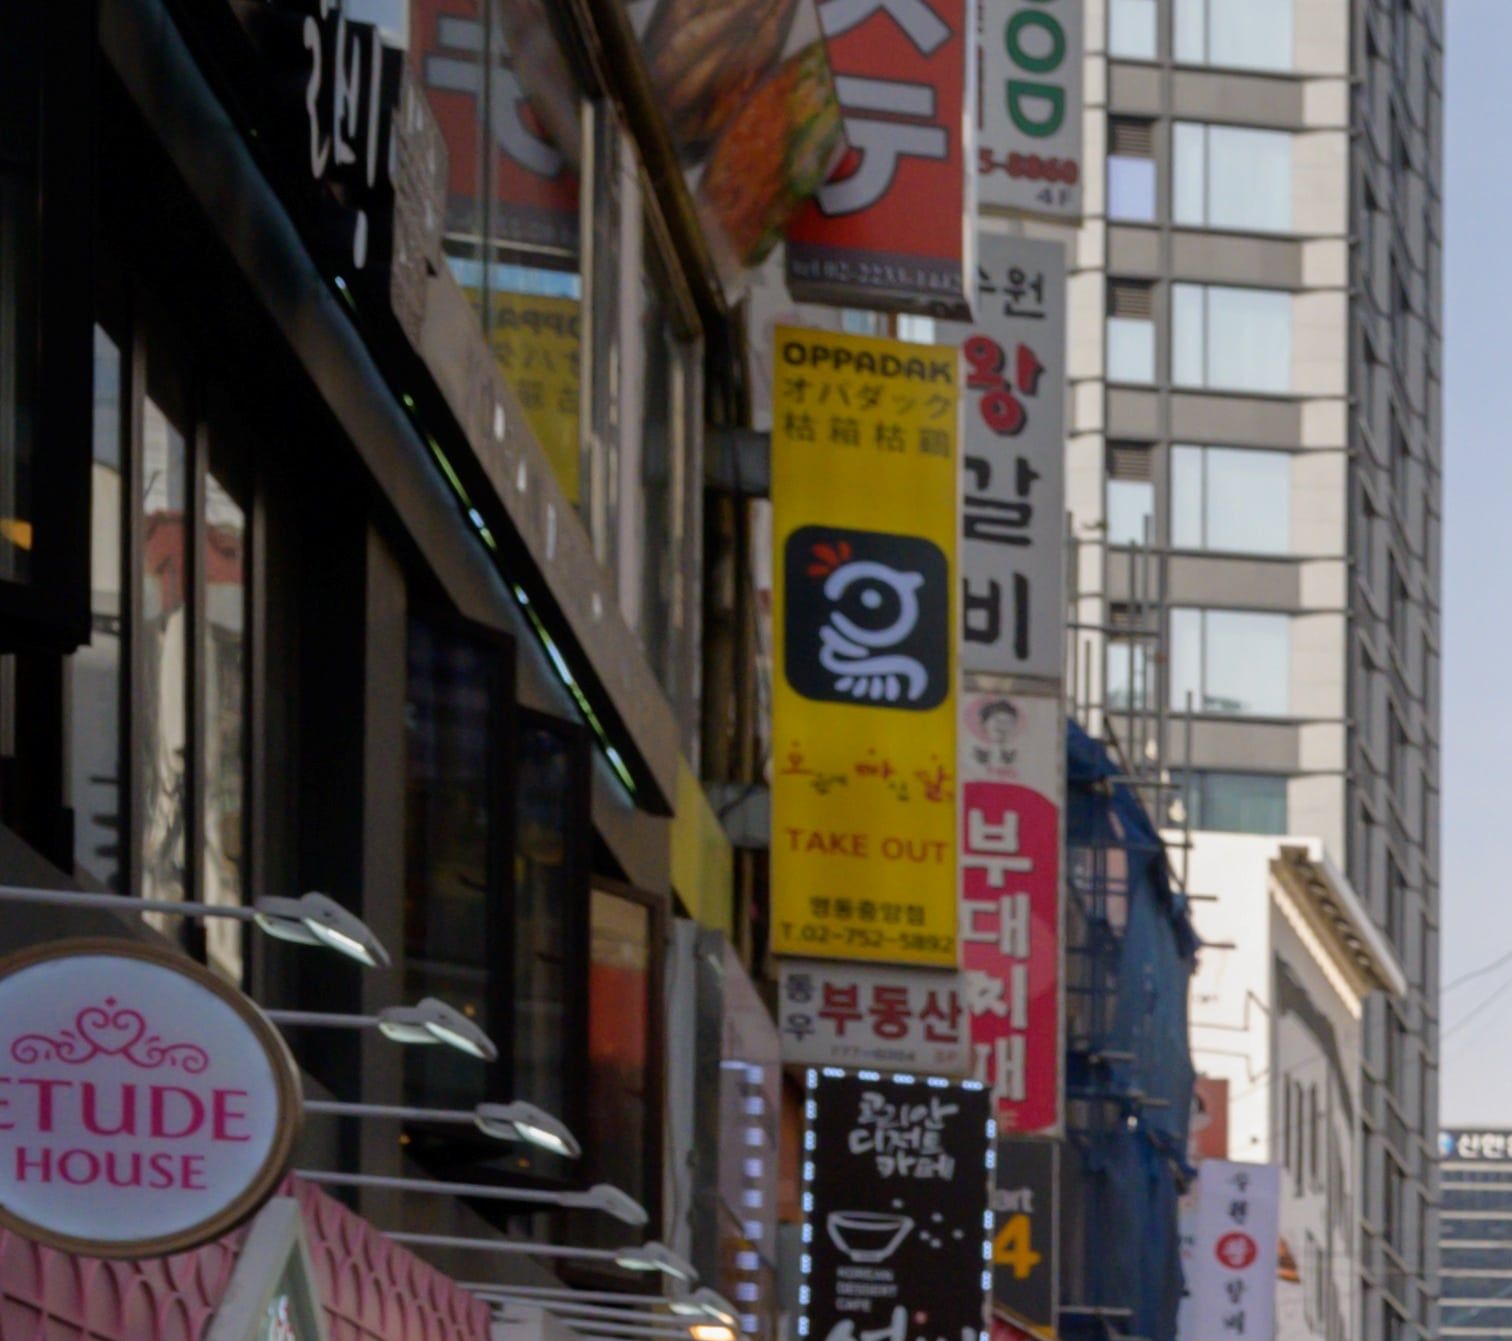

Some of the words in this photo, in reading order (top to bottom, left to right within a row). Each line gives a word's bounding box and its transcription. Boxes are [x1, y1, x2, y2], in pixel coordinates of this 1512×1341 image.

[783, 342, 953, 383] OPPADAK
[785, 827, 871, 859] TAKE
[880, 836, 950, 864] OUT
[962, 809, 1034, 1103] 부대찌개
[819, 981, 962, 1044] 부동산
[15, 1146, 207, 1192] HOUSE
